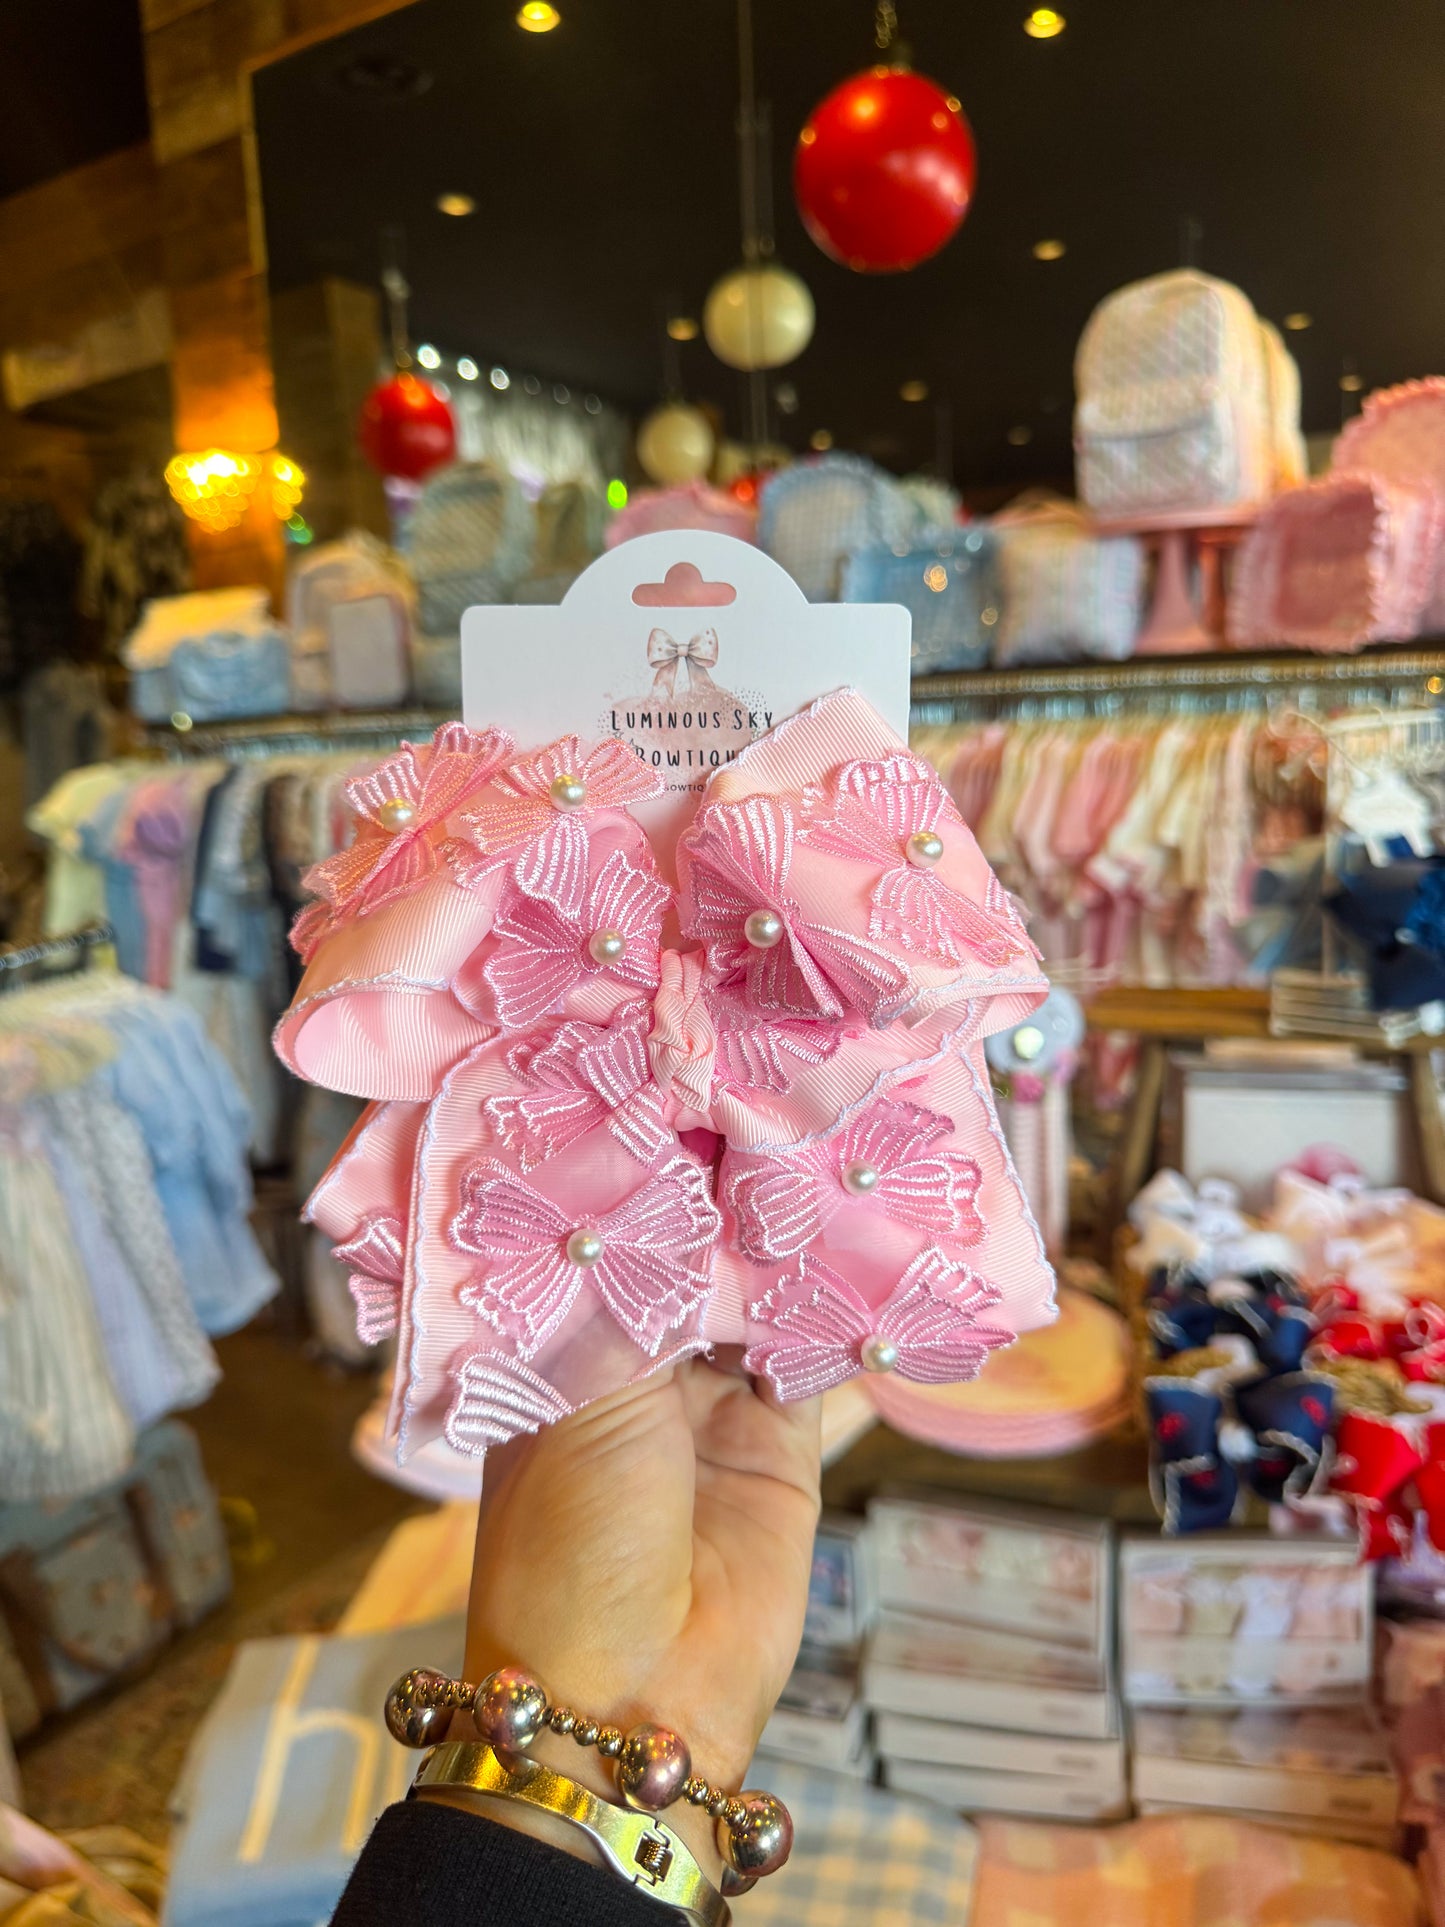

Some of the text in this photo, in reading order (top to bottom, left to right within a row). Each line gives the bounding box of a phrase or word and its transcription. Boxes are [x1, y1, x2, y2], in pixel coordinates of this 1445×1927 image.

[611, 709, 773, 731] LUMINOUS SKY
[665, 784, 705, 793] OWTIQ
